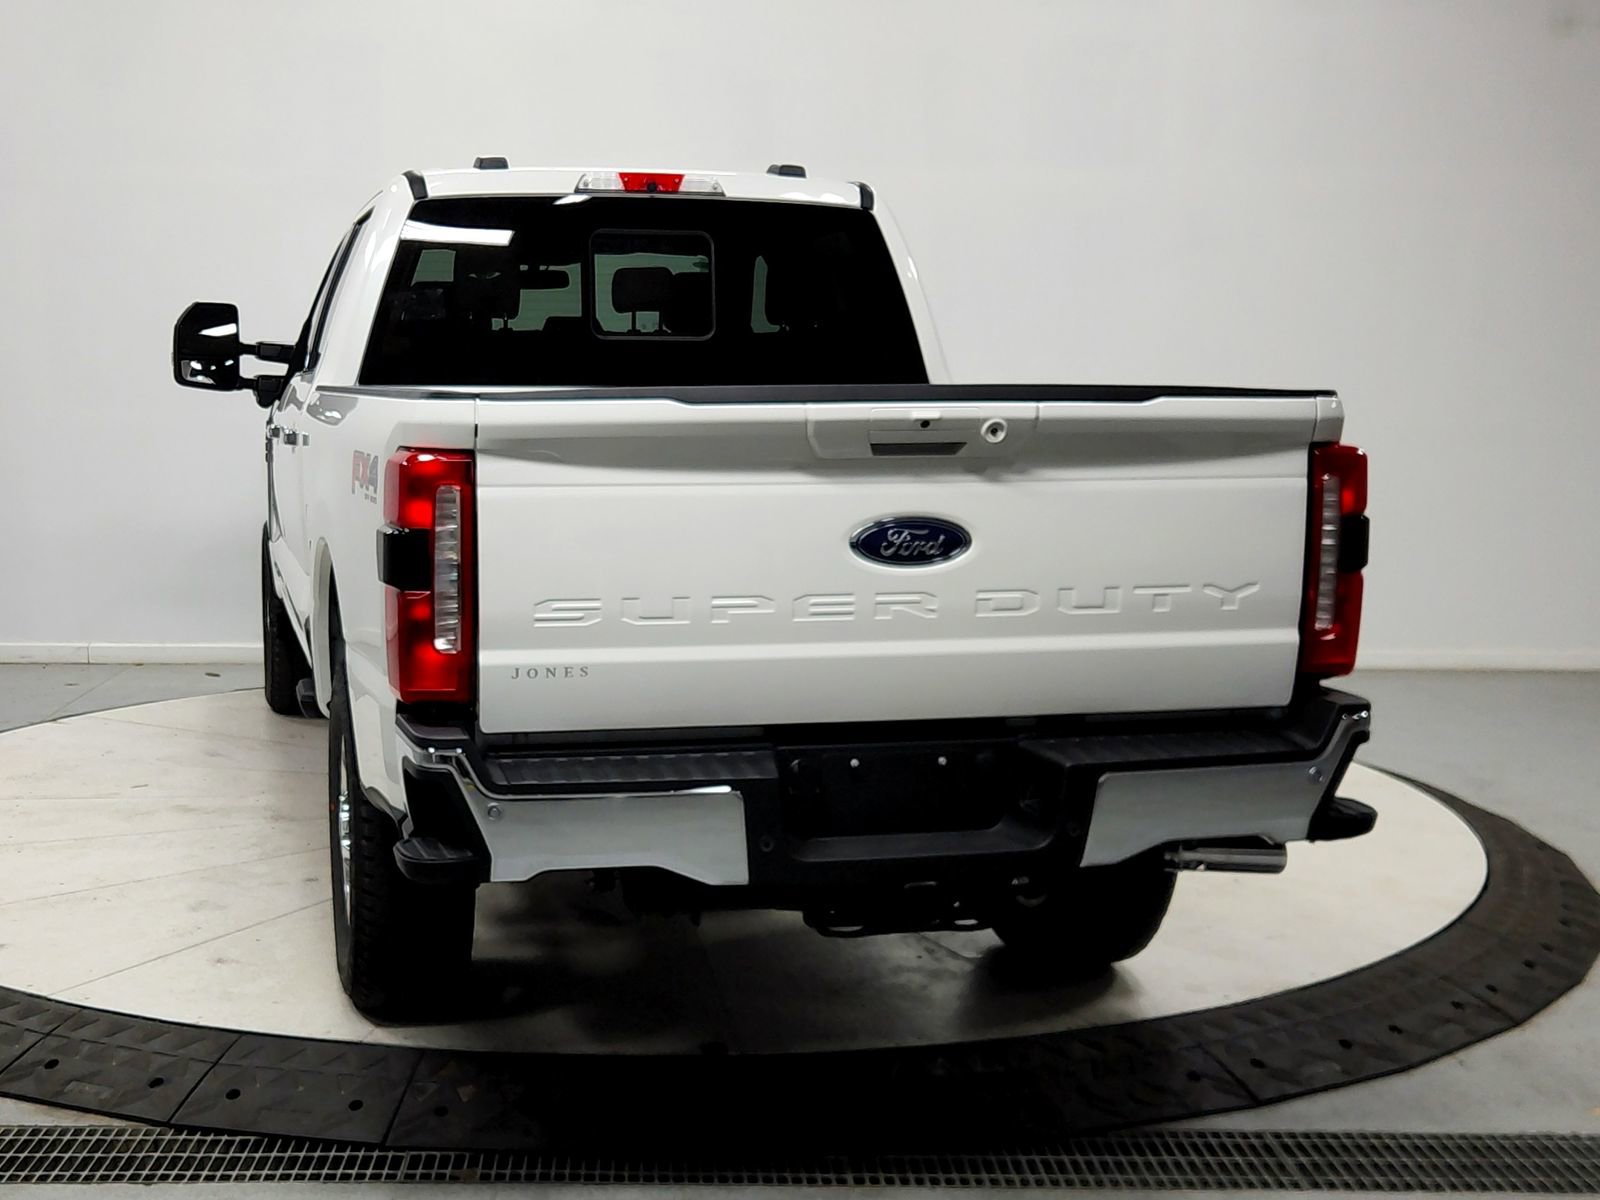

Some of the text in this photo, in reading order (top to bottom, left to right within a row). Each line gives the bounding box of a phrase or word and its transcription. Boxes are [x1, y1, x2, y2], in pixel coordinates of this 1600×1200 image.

[880, 528, 945, 556] Ford
[533, 582, 1261, 628] SUPER DUTY
[511, 665, 589, 679] JONES
